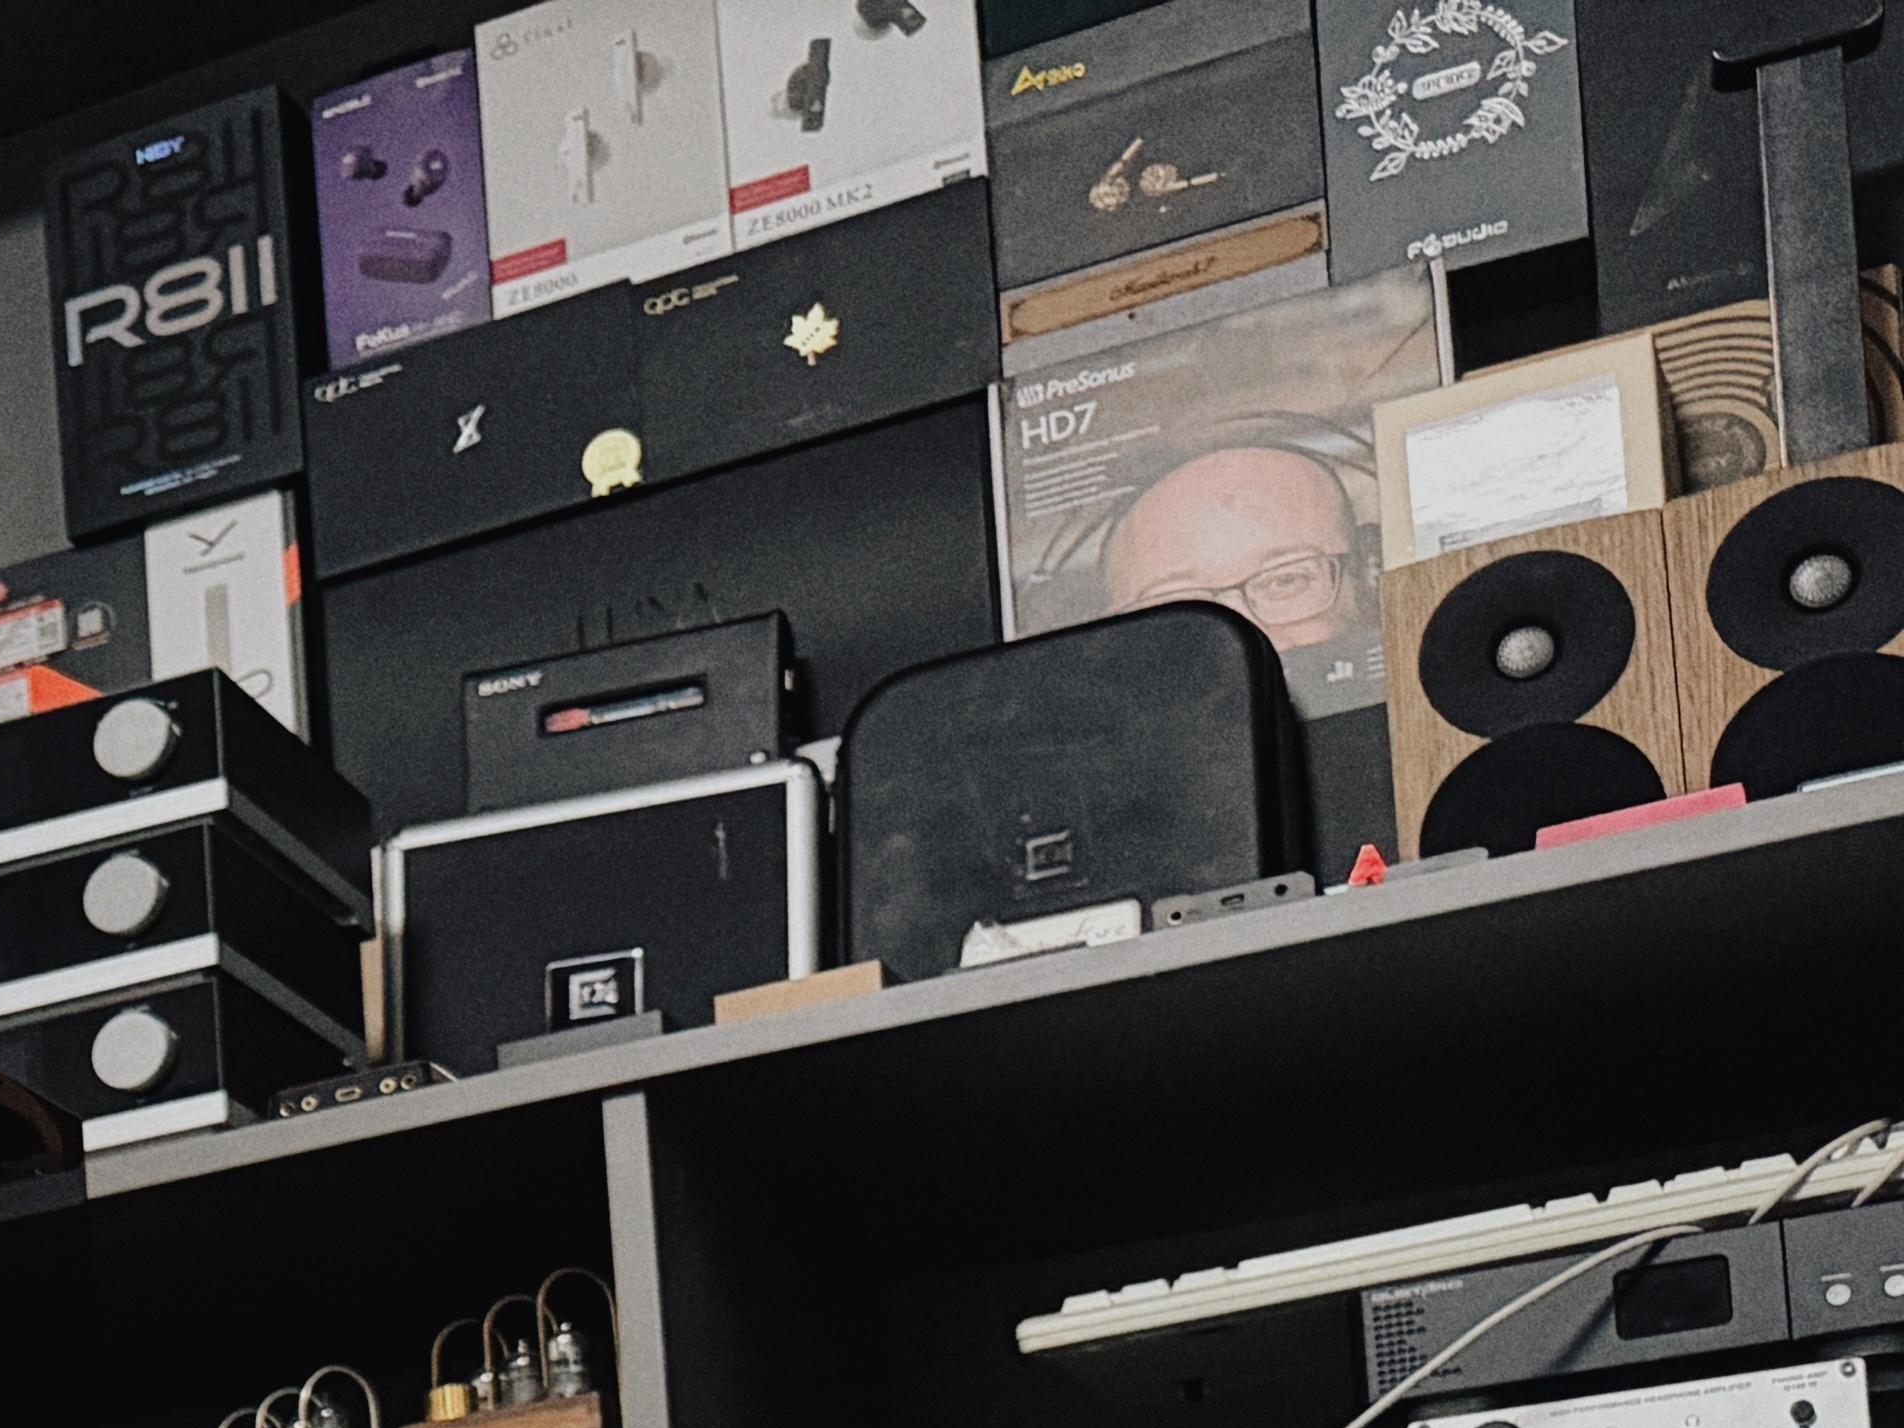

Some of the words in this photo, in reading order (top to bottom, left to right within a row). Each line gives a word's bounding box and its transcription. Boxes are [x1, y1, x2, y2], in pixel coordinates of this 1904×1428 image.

[1046, 362, 1137, 399] PreSonus
[1020, 400, 1098, 449] HD7
[477, 670, 542, 697] SONY
